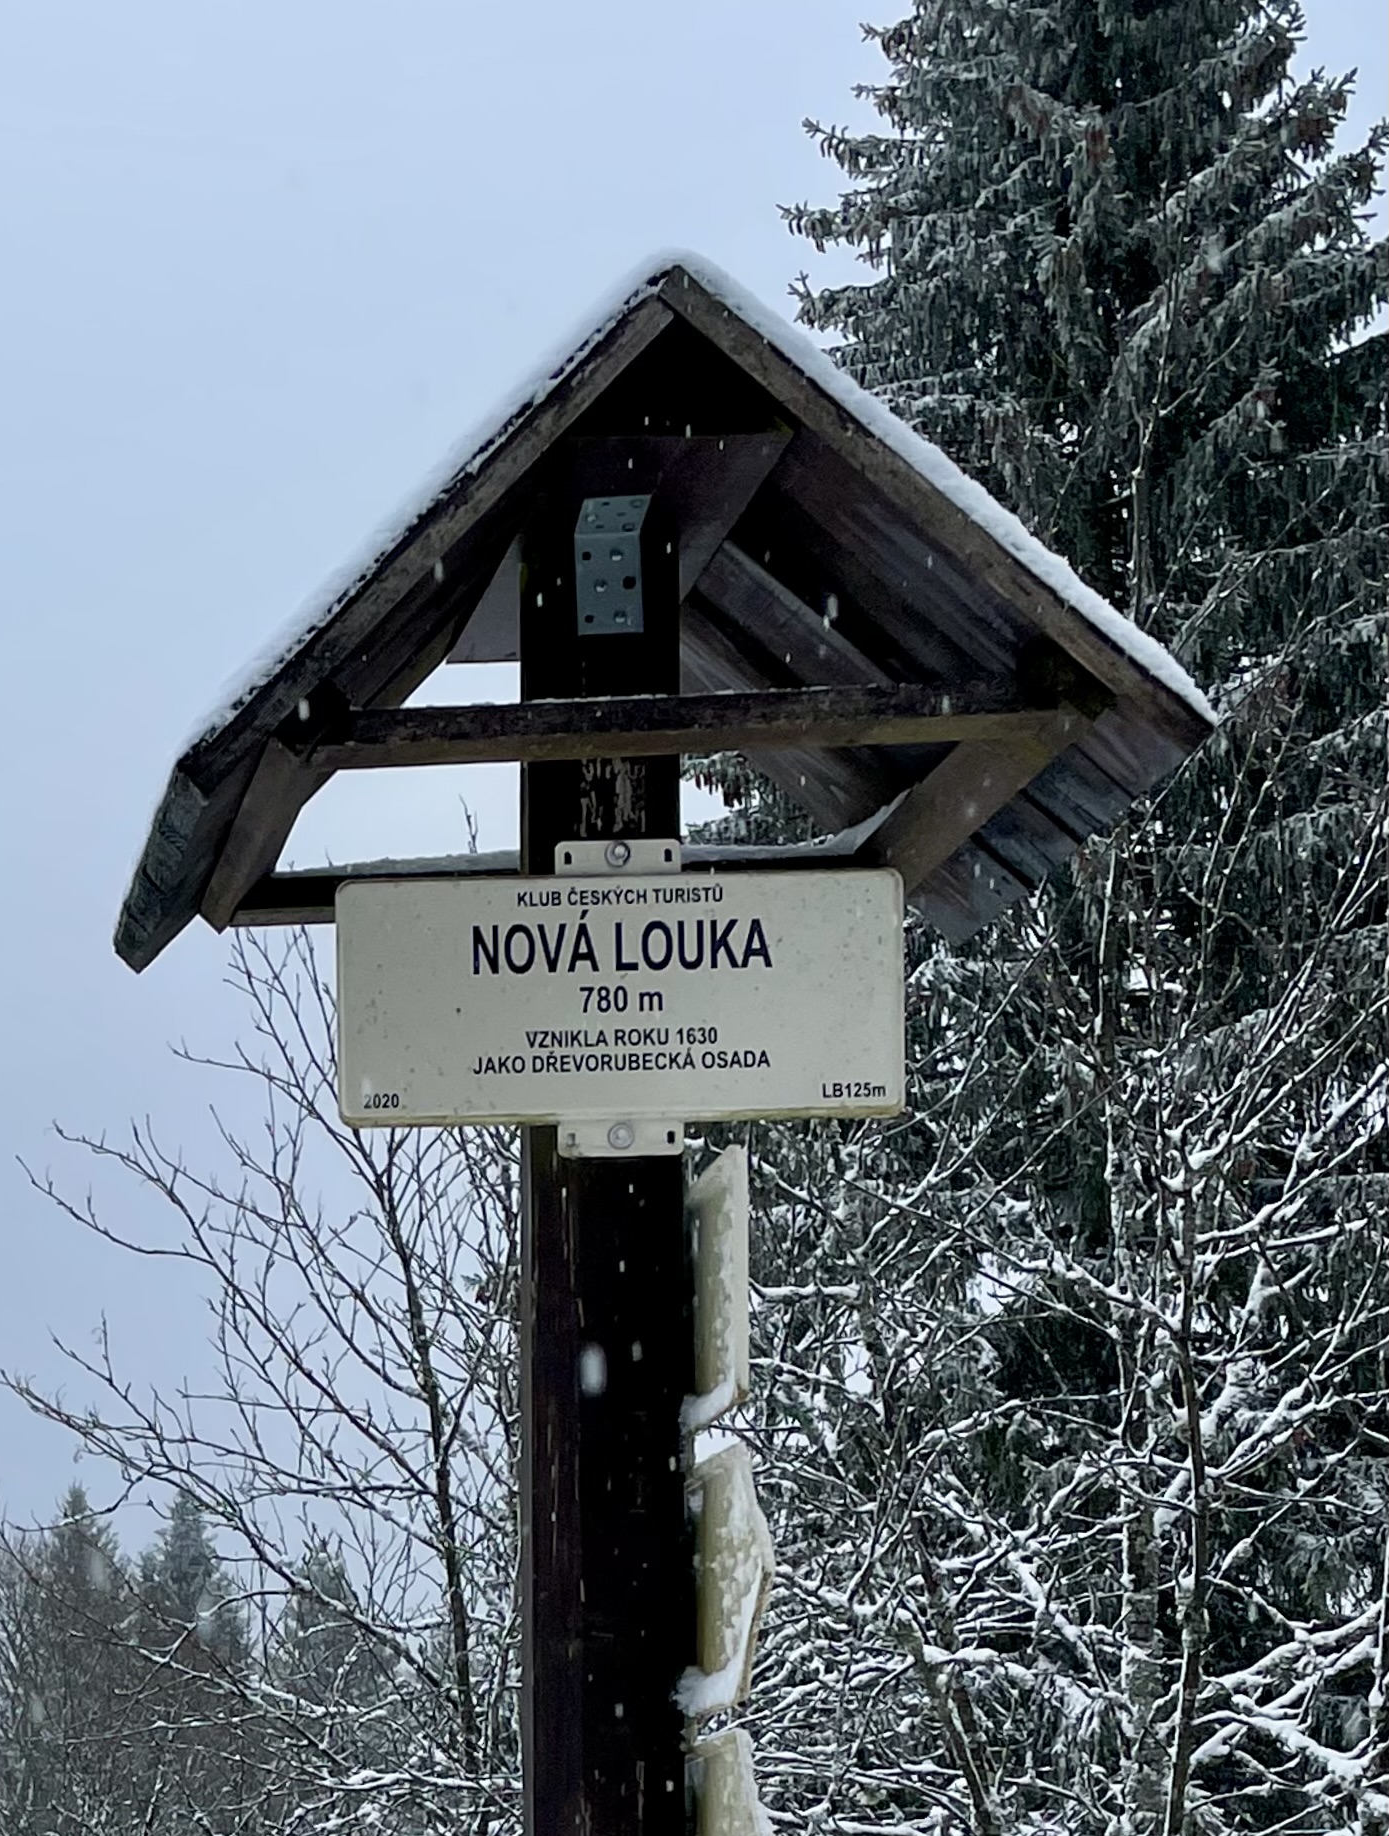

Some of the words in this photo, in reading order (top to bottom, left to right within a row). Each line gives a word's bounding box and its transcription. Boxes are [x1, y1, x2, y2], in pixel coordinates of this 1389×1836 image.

[517, 891, 562, 907] KLUB
[567, 886, 648, 906] ČESKÝCH
[652, 883, 723, 904] TURISTŮ
[471, 909, 600, 976] NOVÁ
[615, 917, 773, 972] LOUKA
[579, 986, 628, 1013] 780
[638, 989, 664, 1011] m
[526, 1030, 609, 1049] VZNIKLA
[614, 1028, 670, 1046] ROKU
[676, 1027, 718, 1045] 1630
[473, 1055, 526, 1075] JAKO
[532, 1048, 696, 1073] DŘEVORUBECKÁ
[701, 1049, 771, 1070] OSADA
[363, 1093, 400, 1110] 2020
[822, 1081, 887, 1099] LB125m
